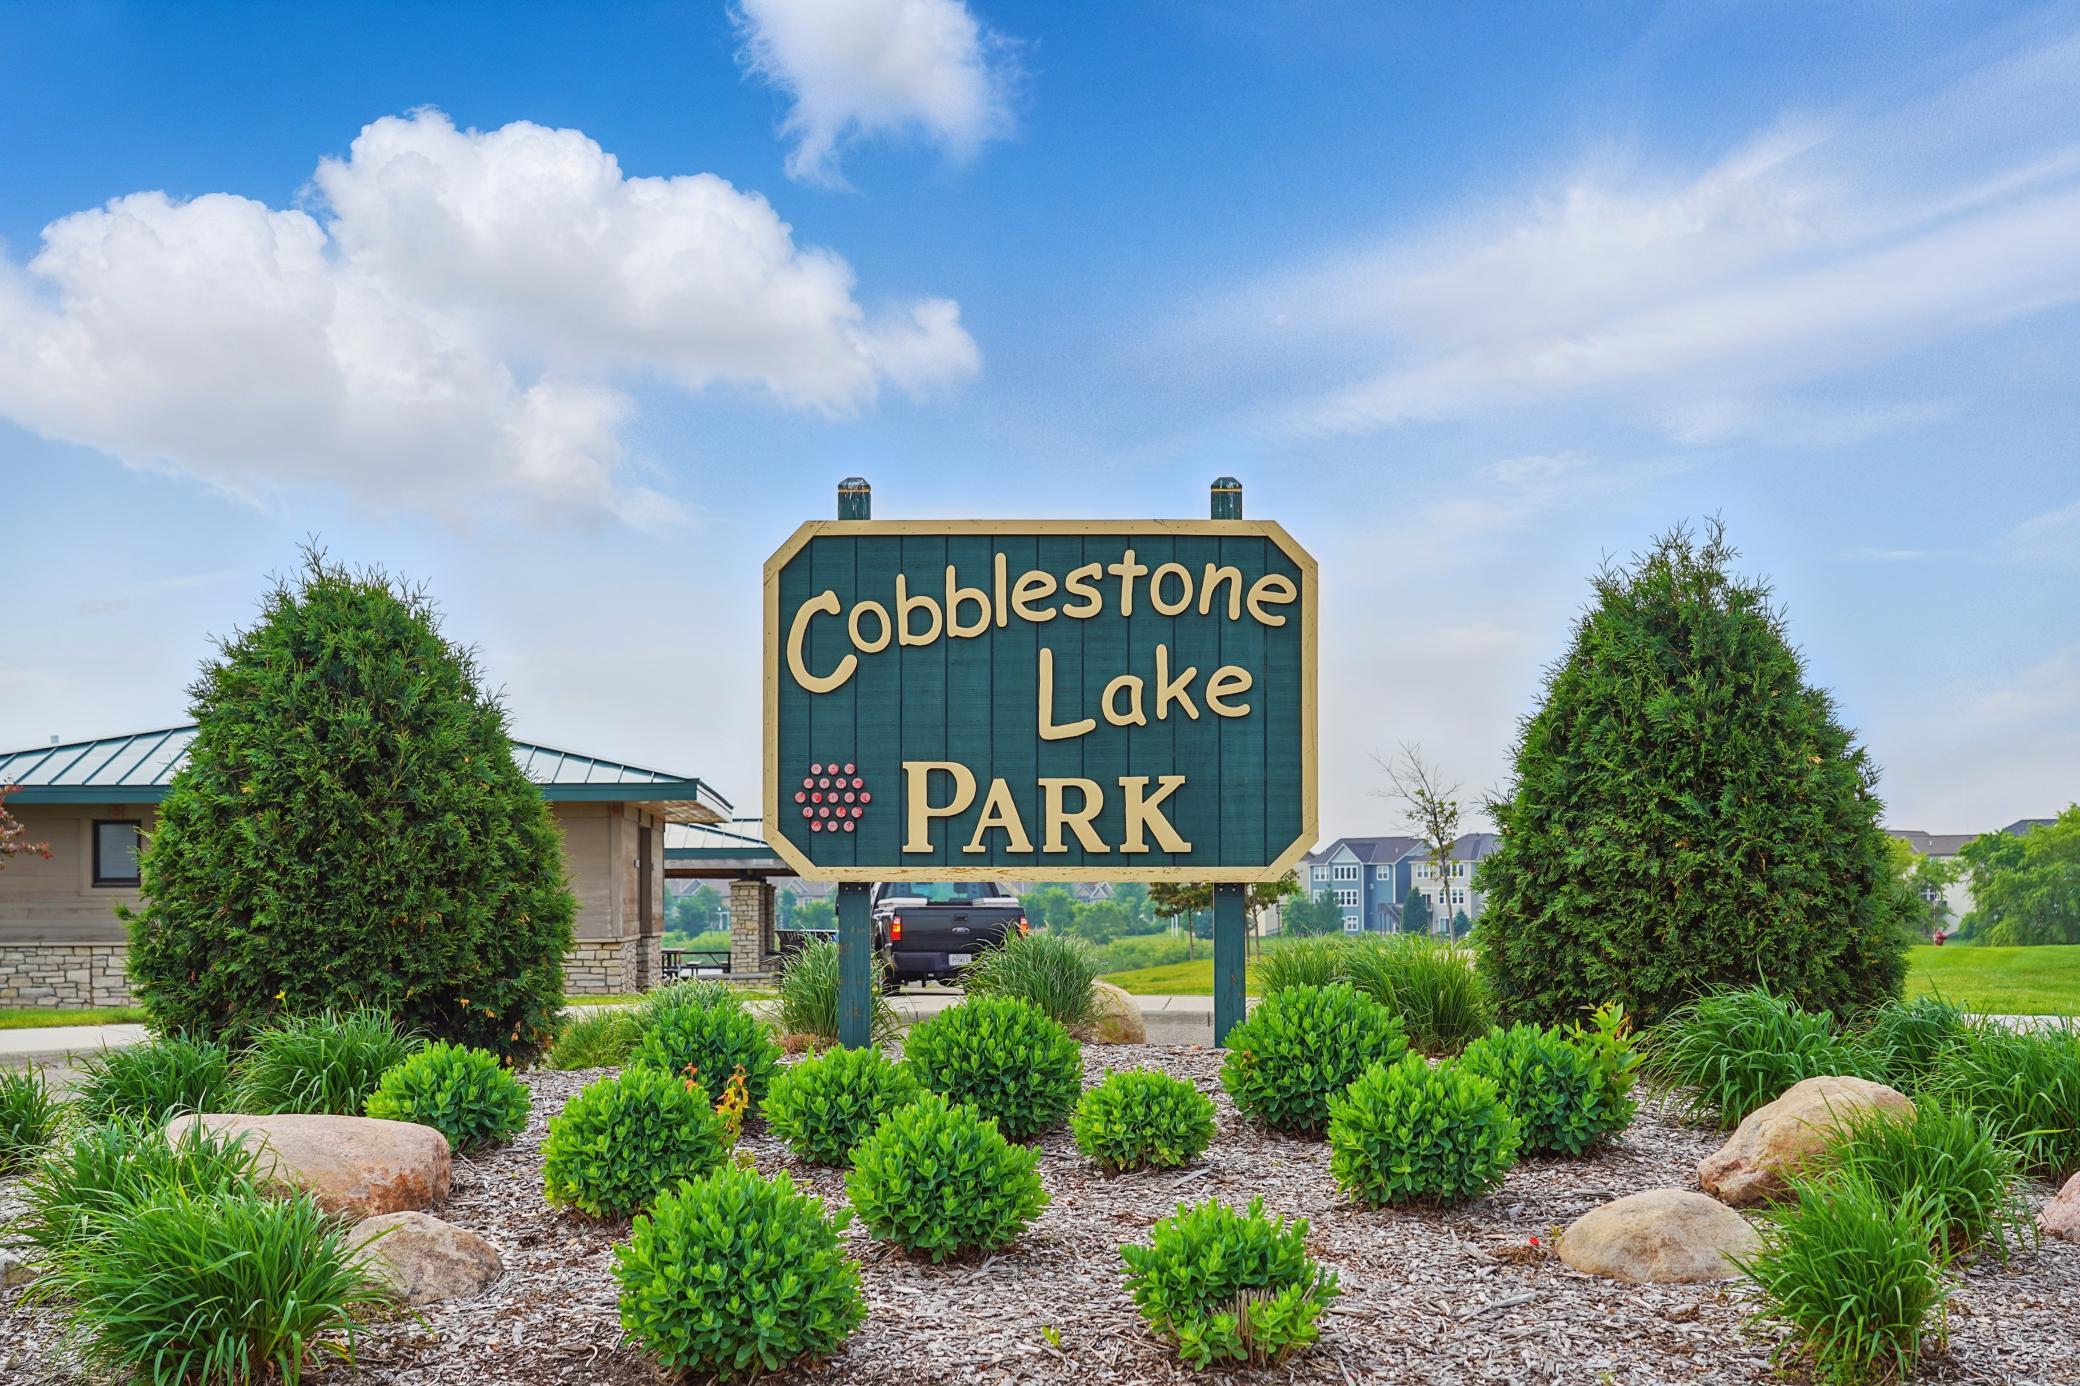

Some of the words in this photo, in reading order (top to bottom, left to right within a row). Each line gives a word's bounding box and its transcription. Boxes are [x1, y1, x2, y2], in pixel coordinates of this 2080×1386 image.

[787, 549, 1297, 693] Cobblestone
[1039, 644, 1253, 740] Lake
[902, 761, 1192, 853] PARK
